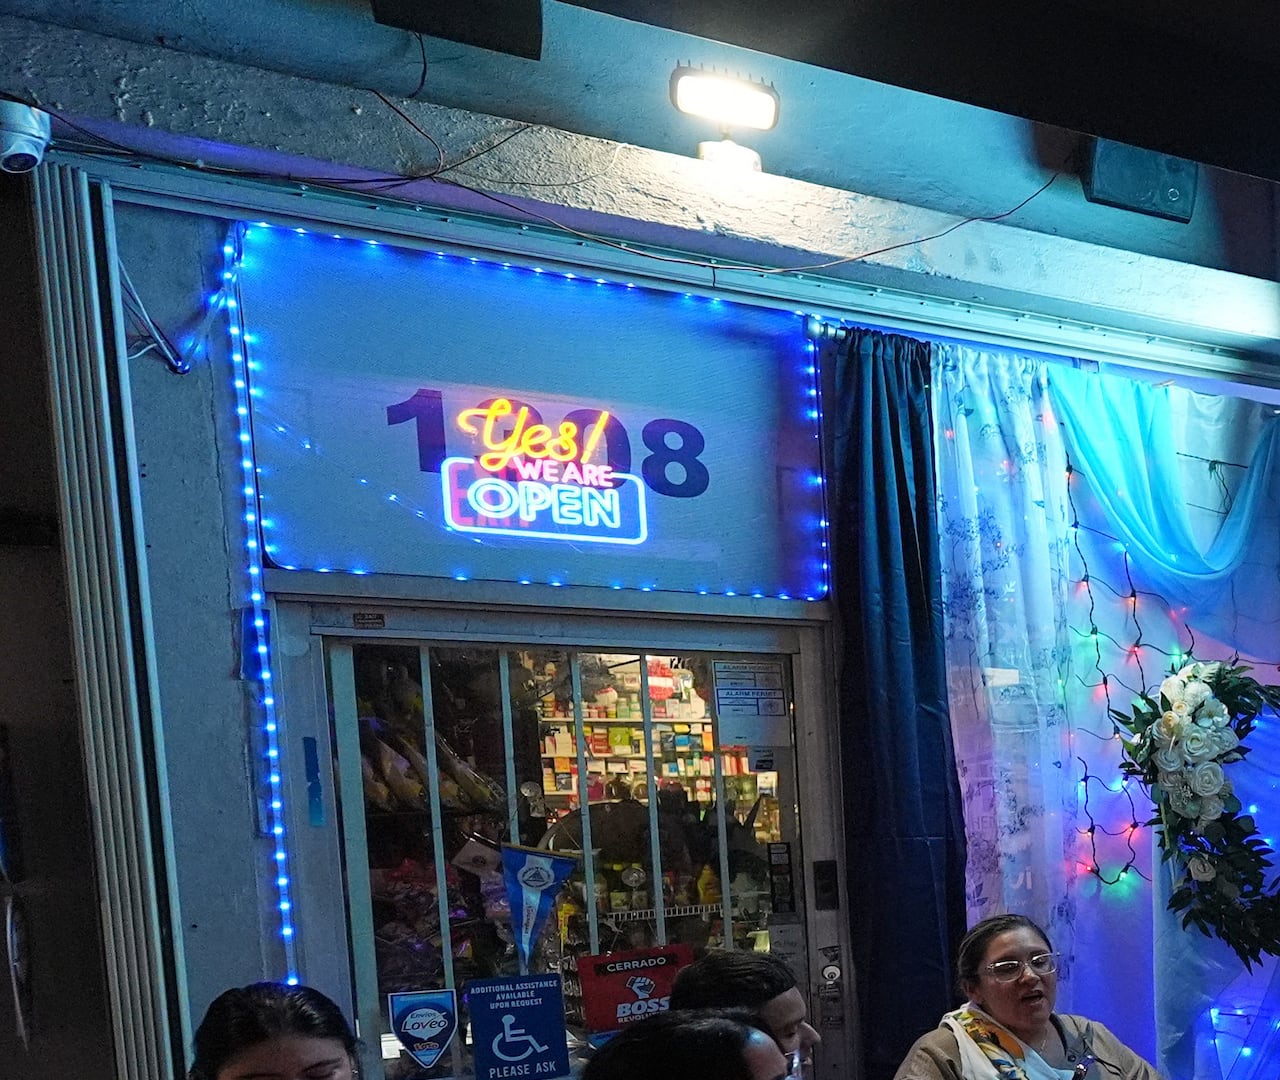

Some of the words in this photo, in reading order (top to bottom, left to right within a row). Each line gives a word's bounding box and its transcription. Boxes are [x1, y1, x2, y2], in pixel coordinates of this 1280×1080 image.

[457, 398, 610, 472] Yes!
[514, 457, 559, 481] WE
[562, 462, 613, 487] ARE
[467, 477, 621, 529] OPEN
[606, 957, 667, 972] CERRADO
[470, 985, 513, 994] ADDITIONAL
[515, 980, 558, 990] ASSISTANCE
[496, 990, 535, 1001] AVAILABLE
[489, 1001, 510, 1009] UPON
[511, 998, 543, 1007] REQUEST
[616, 996, 671, 1018] BOSS
[403, 1015, 447, 1031] Loveo
[489, 1064, 530, 1079] PLEASE
[535, 1060, 556, 1073] ASK
